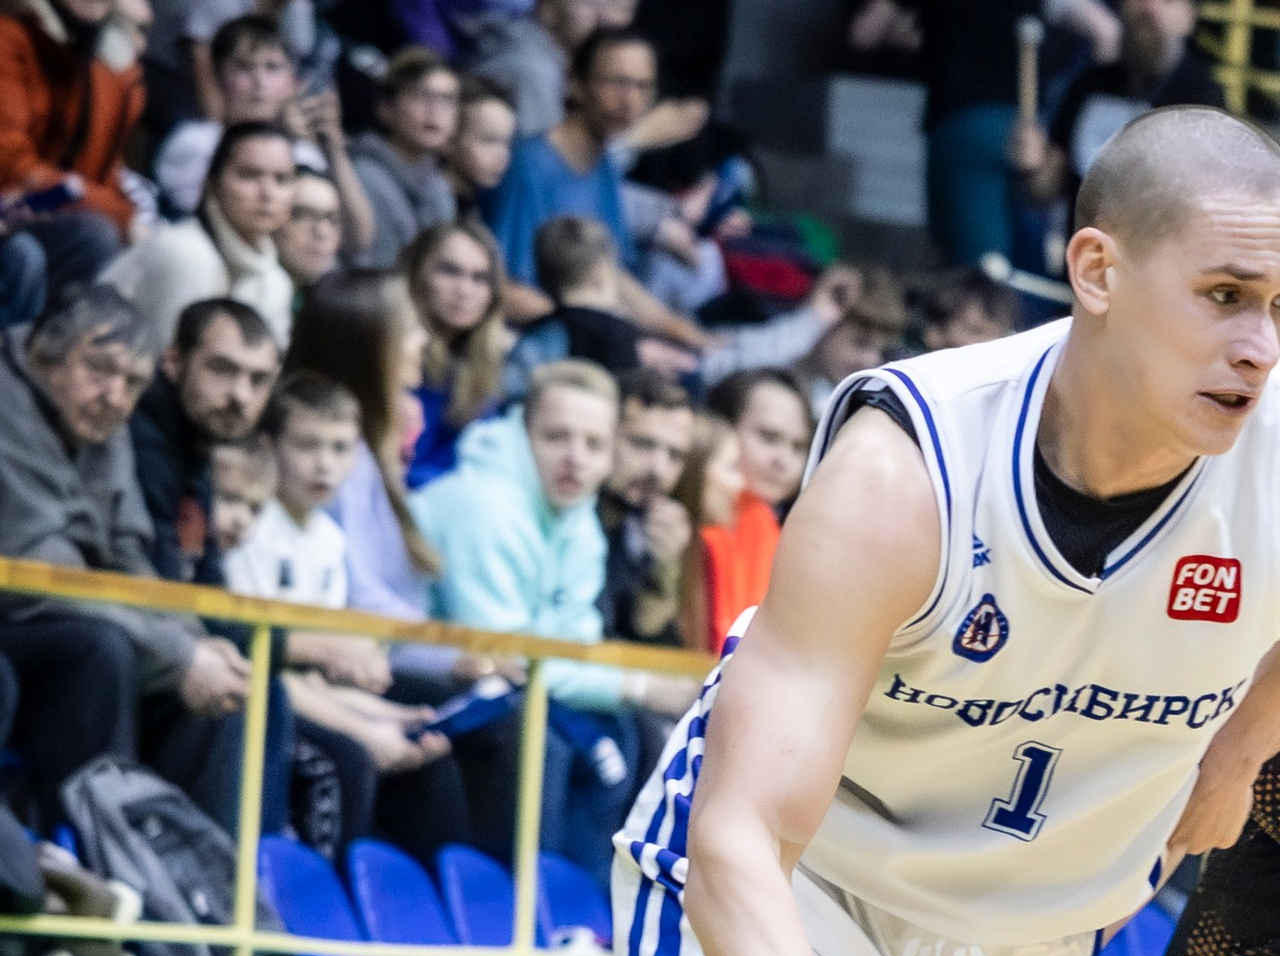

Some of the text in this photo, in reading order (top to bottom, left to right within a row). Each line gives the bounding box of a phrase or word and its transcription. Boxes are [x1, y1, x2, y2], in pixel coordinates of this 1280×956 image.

[1176, 563, 1238, 590] FON
[1172, 588, 1238, 615] BET
[981, 740, 1063, 842] 1
